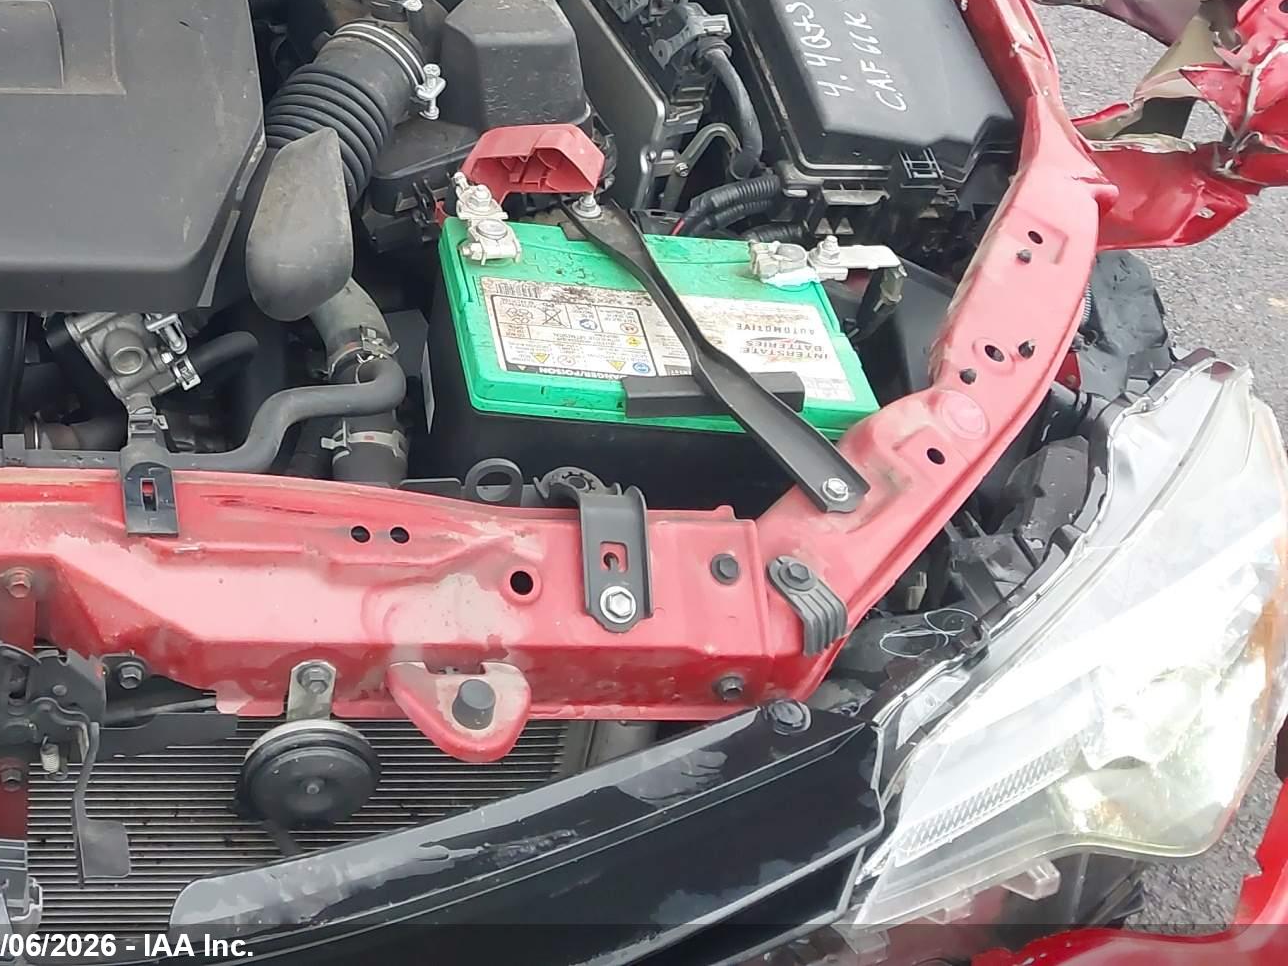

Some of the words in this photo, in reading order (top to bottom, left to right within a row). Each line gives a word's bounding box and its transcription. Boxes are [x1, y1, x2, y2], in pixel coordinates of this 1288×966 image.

[735, 322, 815, 336] AUTOMOTIVE
[745, 340, 823, 352] BATTERIES
[742, 347, 828, 360] INTERSTATE
